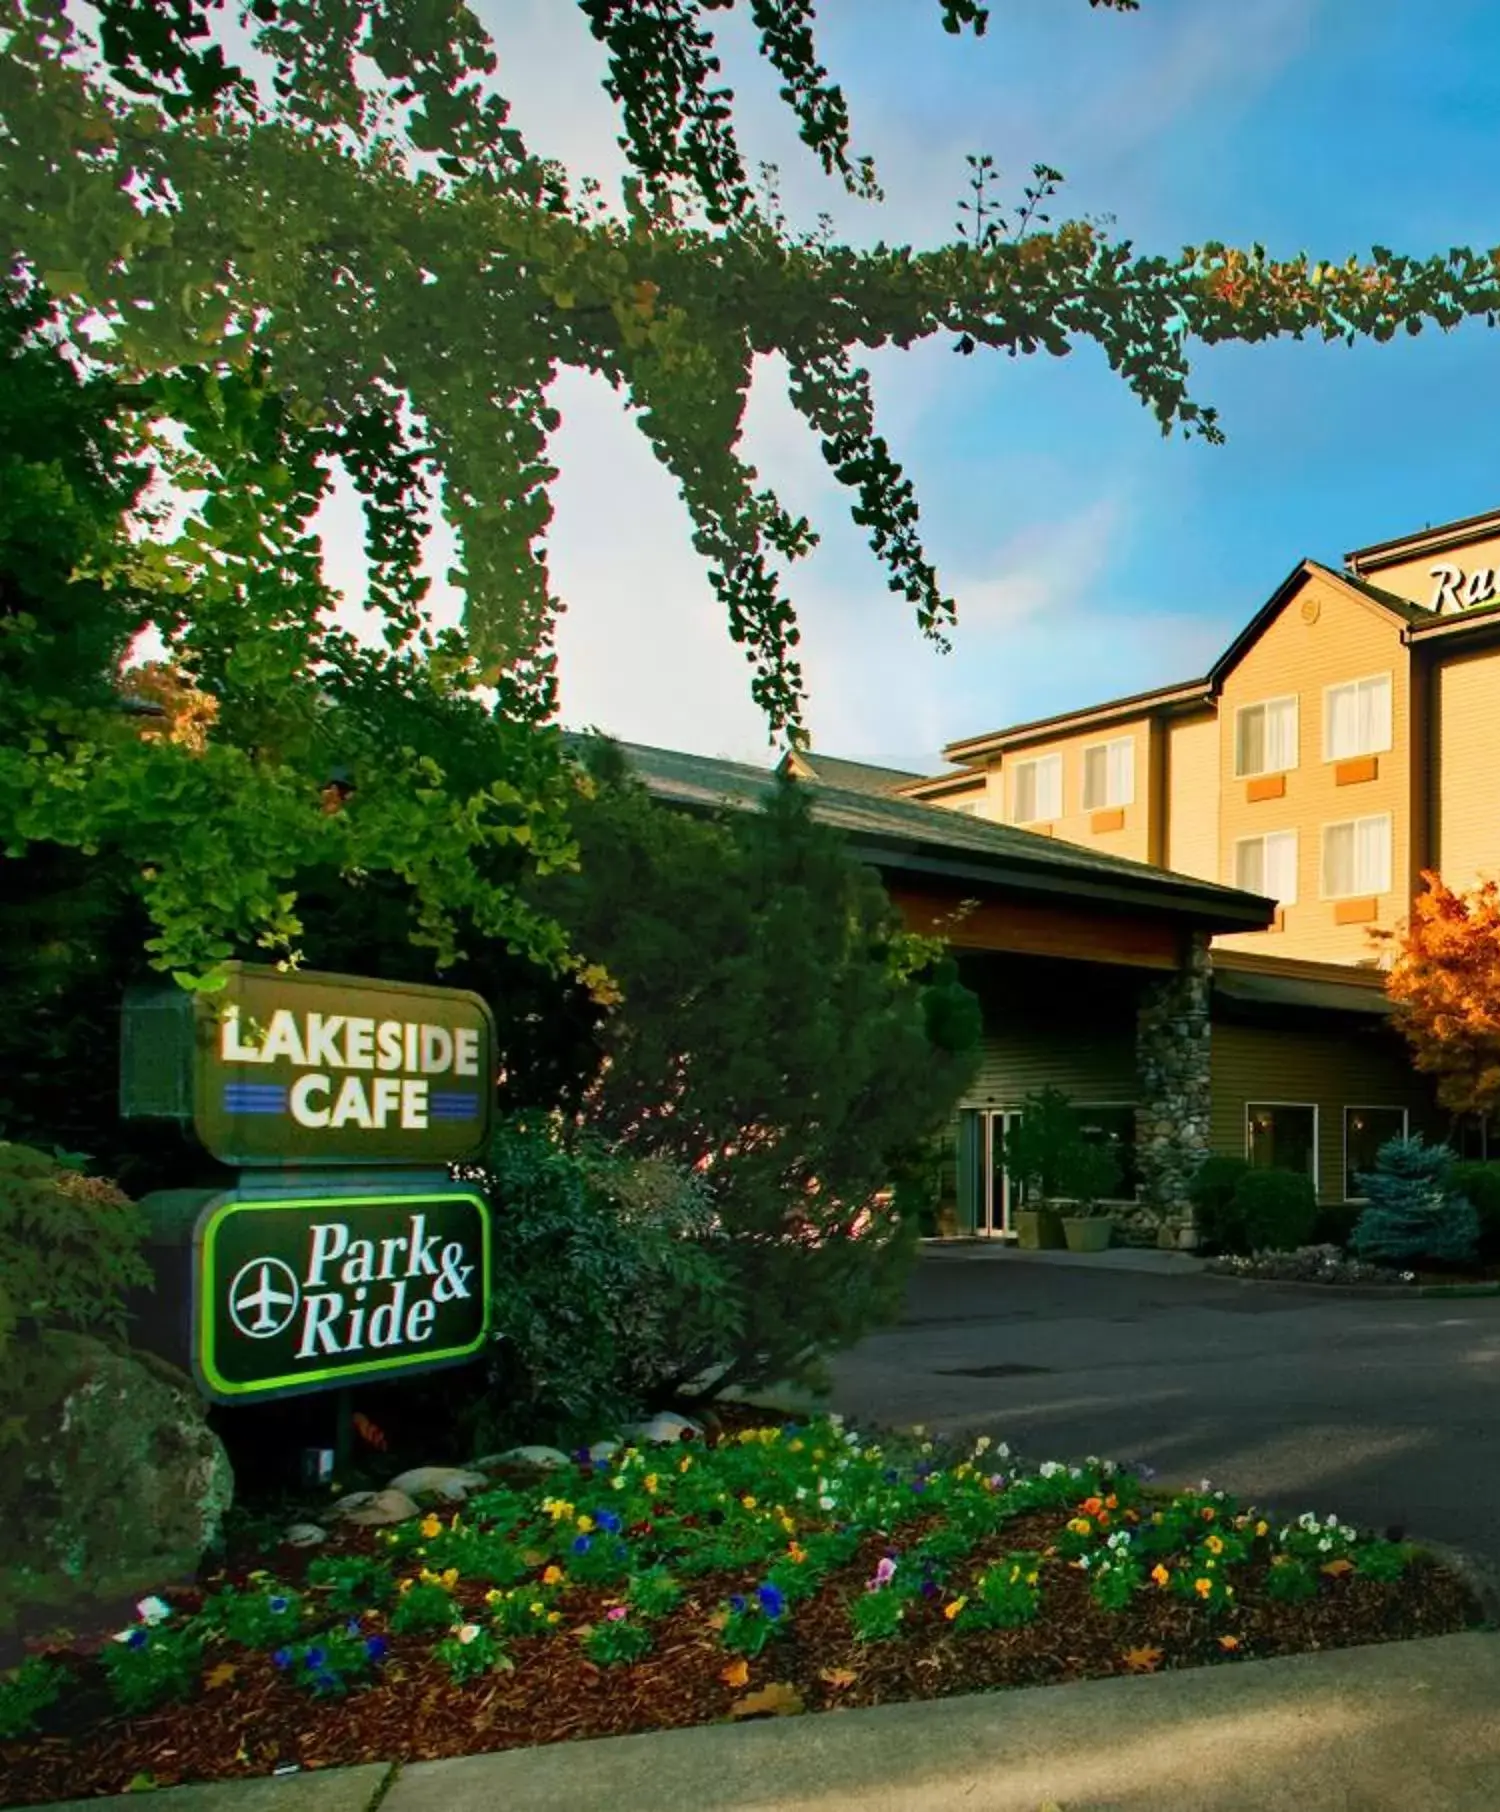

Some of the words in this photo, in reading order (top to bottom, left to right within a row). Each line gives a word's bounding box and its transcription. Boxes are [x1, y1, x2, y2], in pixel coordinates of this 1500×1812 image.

[221, 1006, 479, 1076] LAKESIDE
[290, 1073, 428, 1129] CAFE
[302, 1214, 442, 1287] Park
[432, 1242, 475, 1303] &
[294, 1280, 436, 1359] Ride
